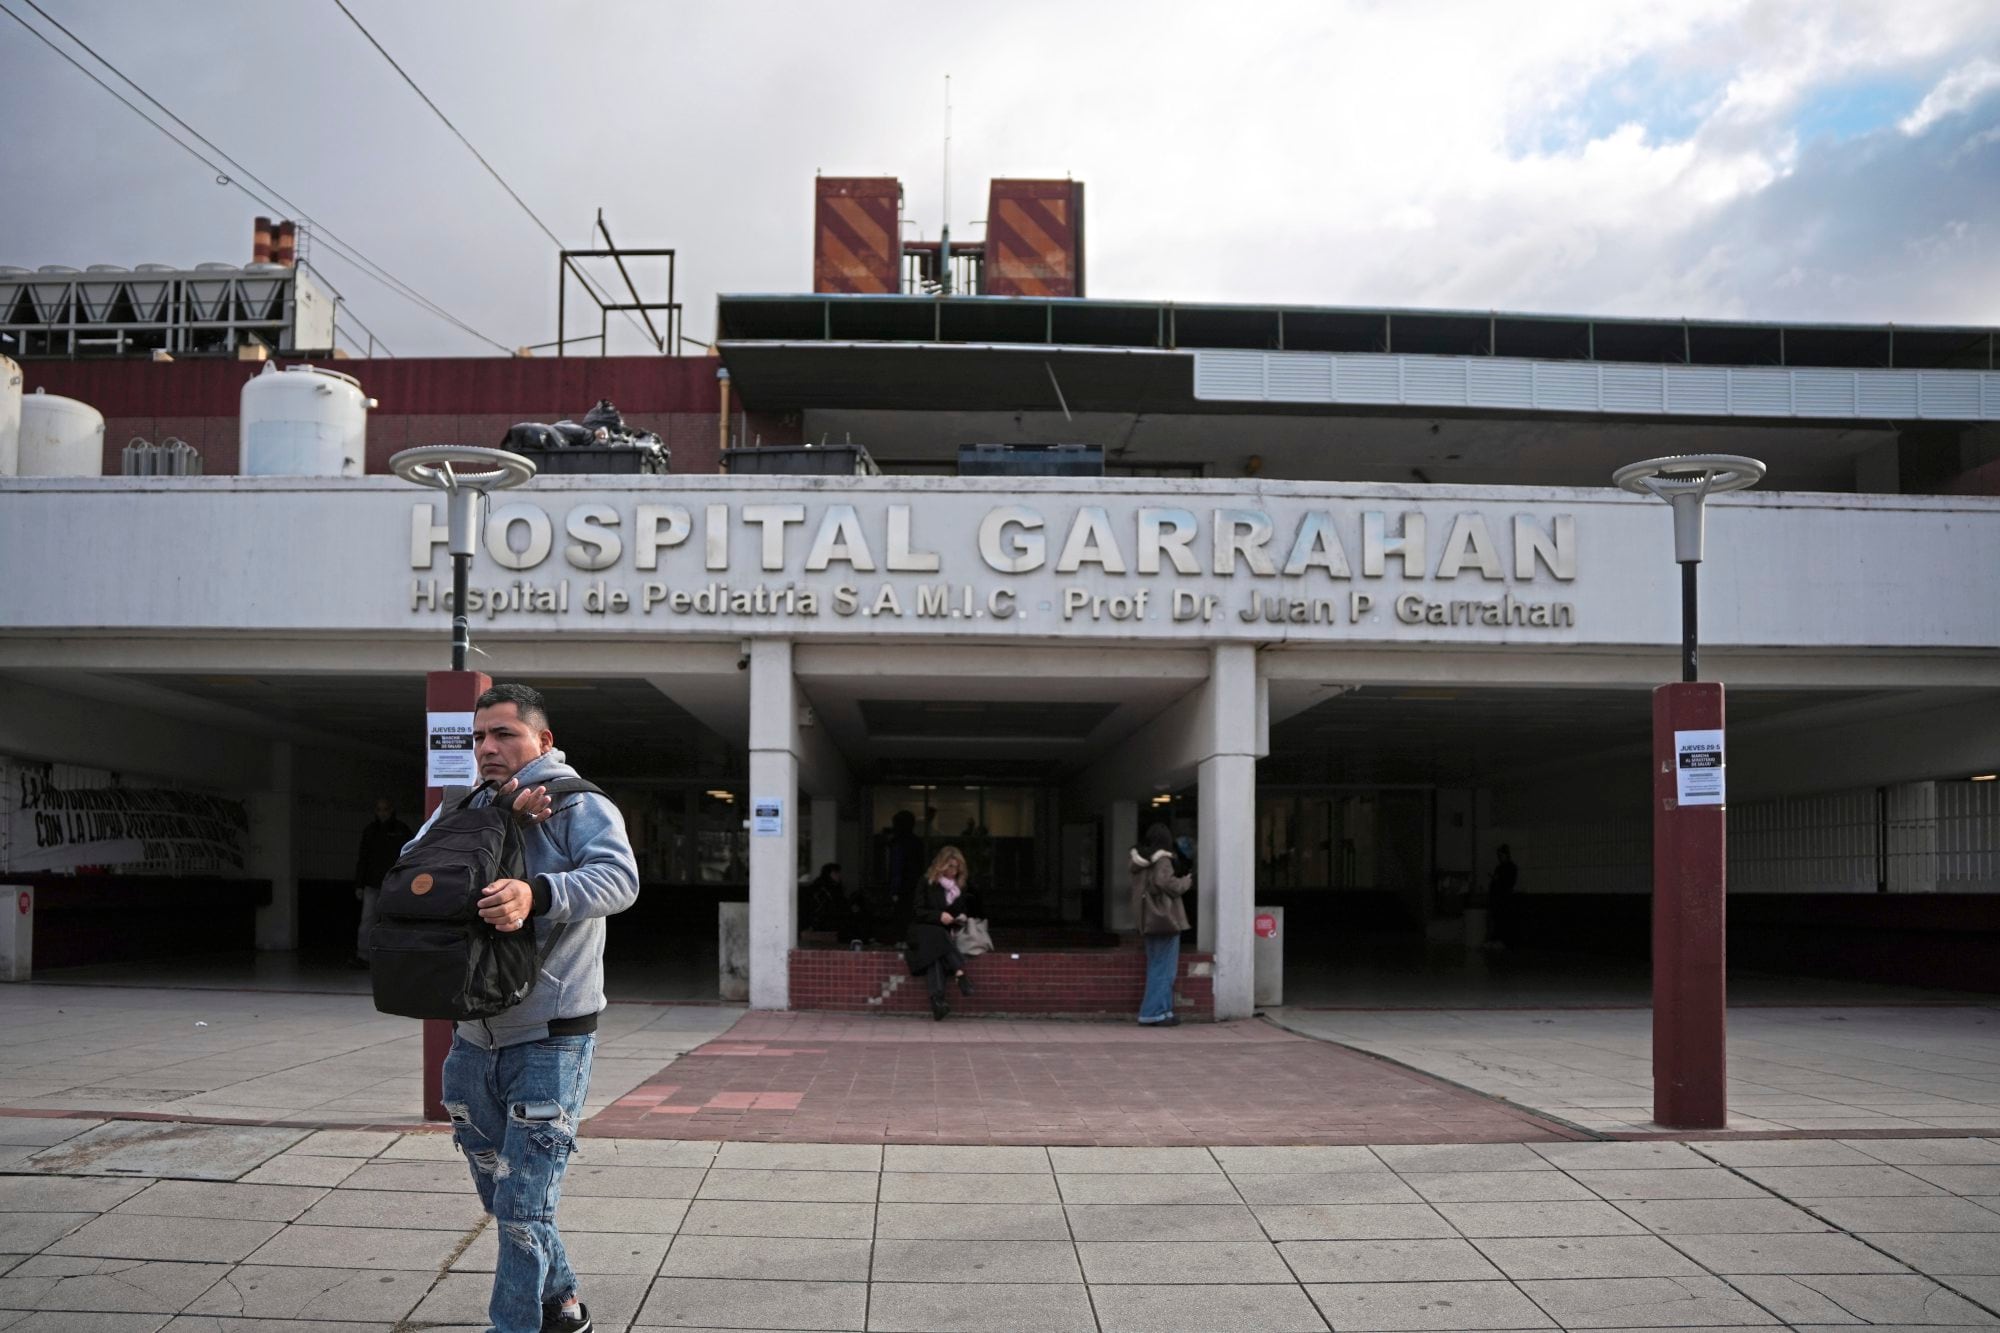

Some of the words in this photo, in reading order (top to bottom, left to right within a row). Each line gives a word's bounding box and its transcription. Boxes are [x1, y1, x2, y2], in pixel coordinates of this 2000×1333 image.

[978, 505, 1576, 581] GARRAHAN
[582, 580, 629, 614] de
[642, 581, 819, 617] Pediatria
[1238, 590, 1334, 623] Juan
[1396, 593, 1576, 628] Garrahan
[35, 810, 64, 846] CON
[66, 811, 86, 844] LA
